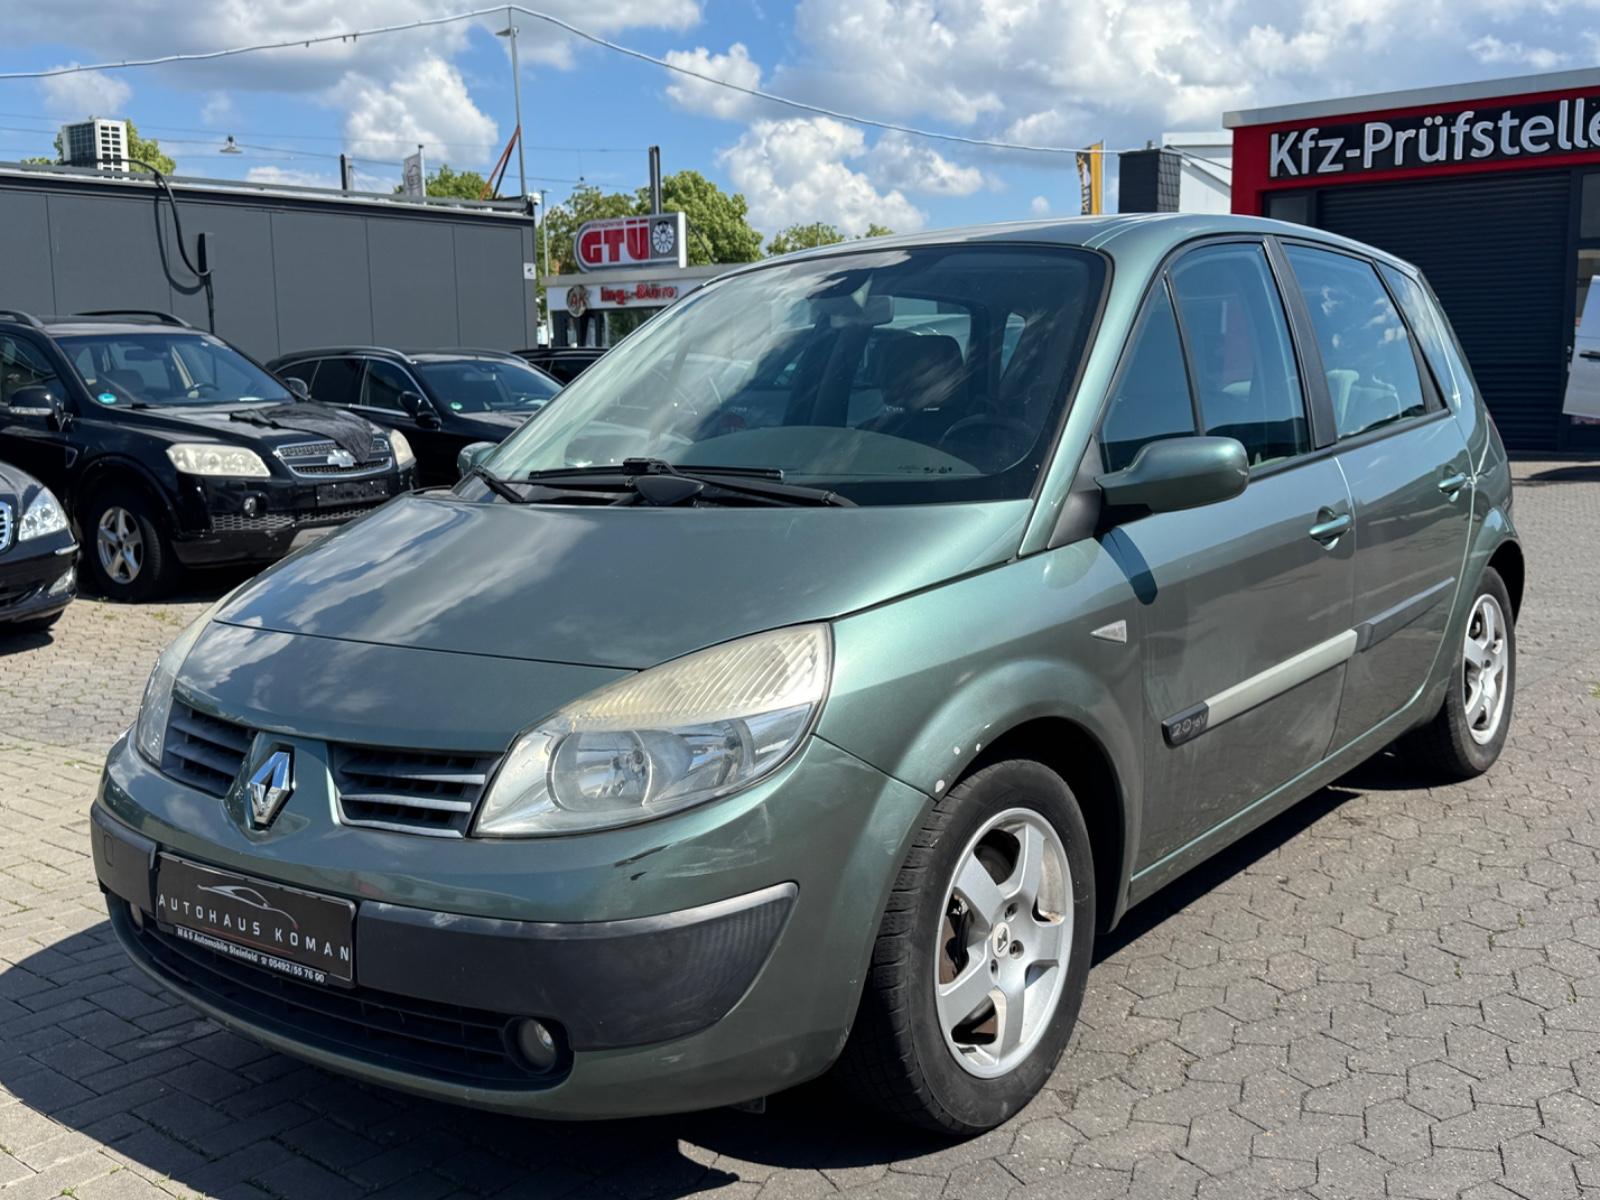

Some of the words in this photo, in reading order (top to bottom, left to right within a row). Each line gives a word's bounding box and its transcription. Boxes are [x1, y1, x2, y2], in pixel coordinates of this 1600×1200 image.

[581, 218, 649, 264] GTÜ
[158, 893, 261, 935] AUTOHAUS
[274, 928, 350, 961] KOMAN
[194, 933, 228, 952] Automobile
